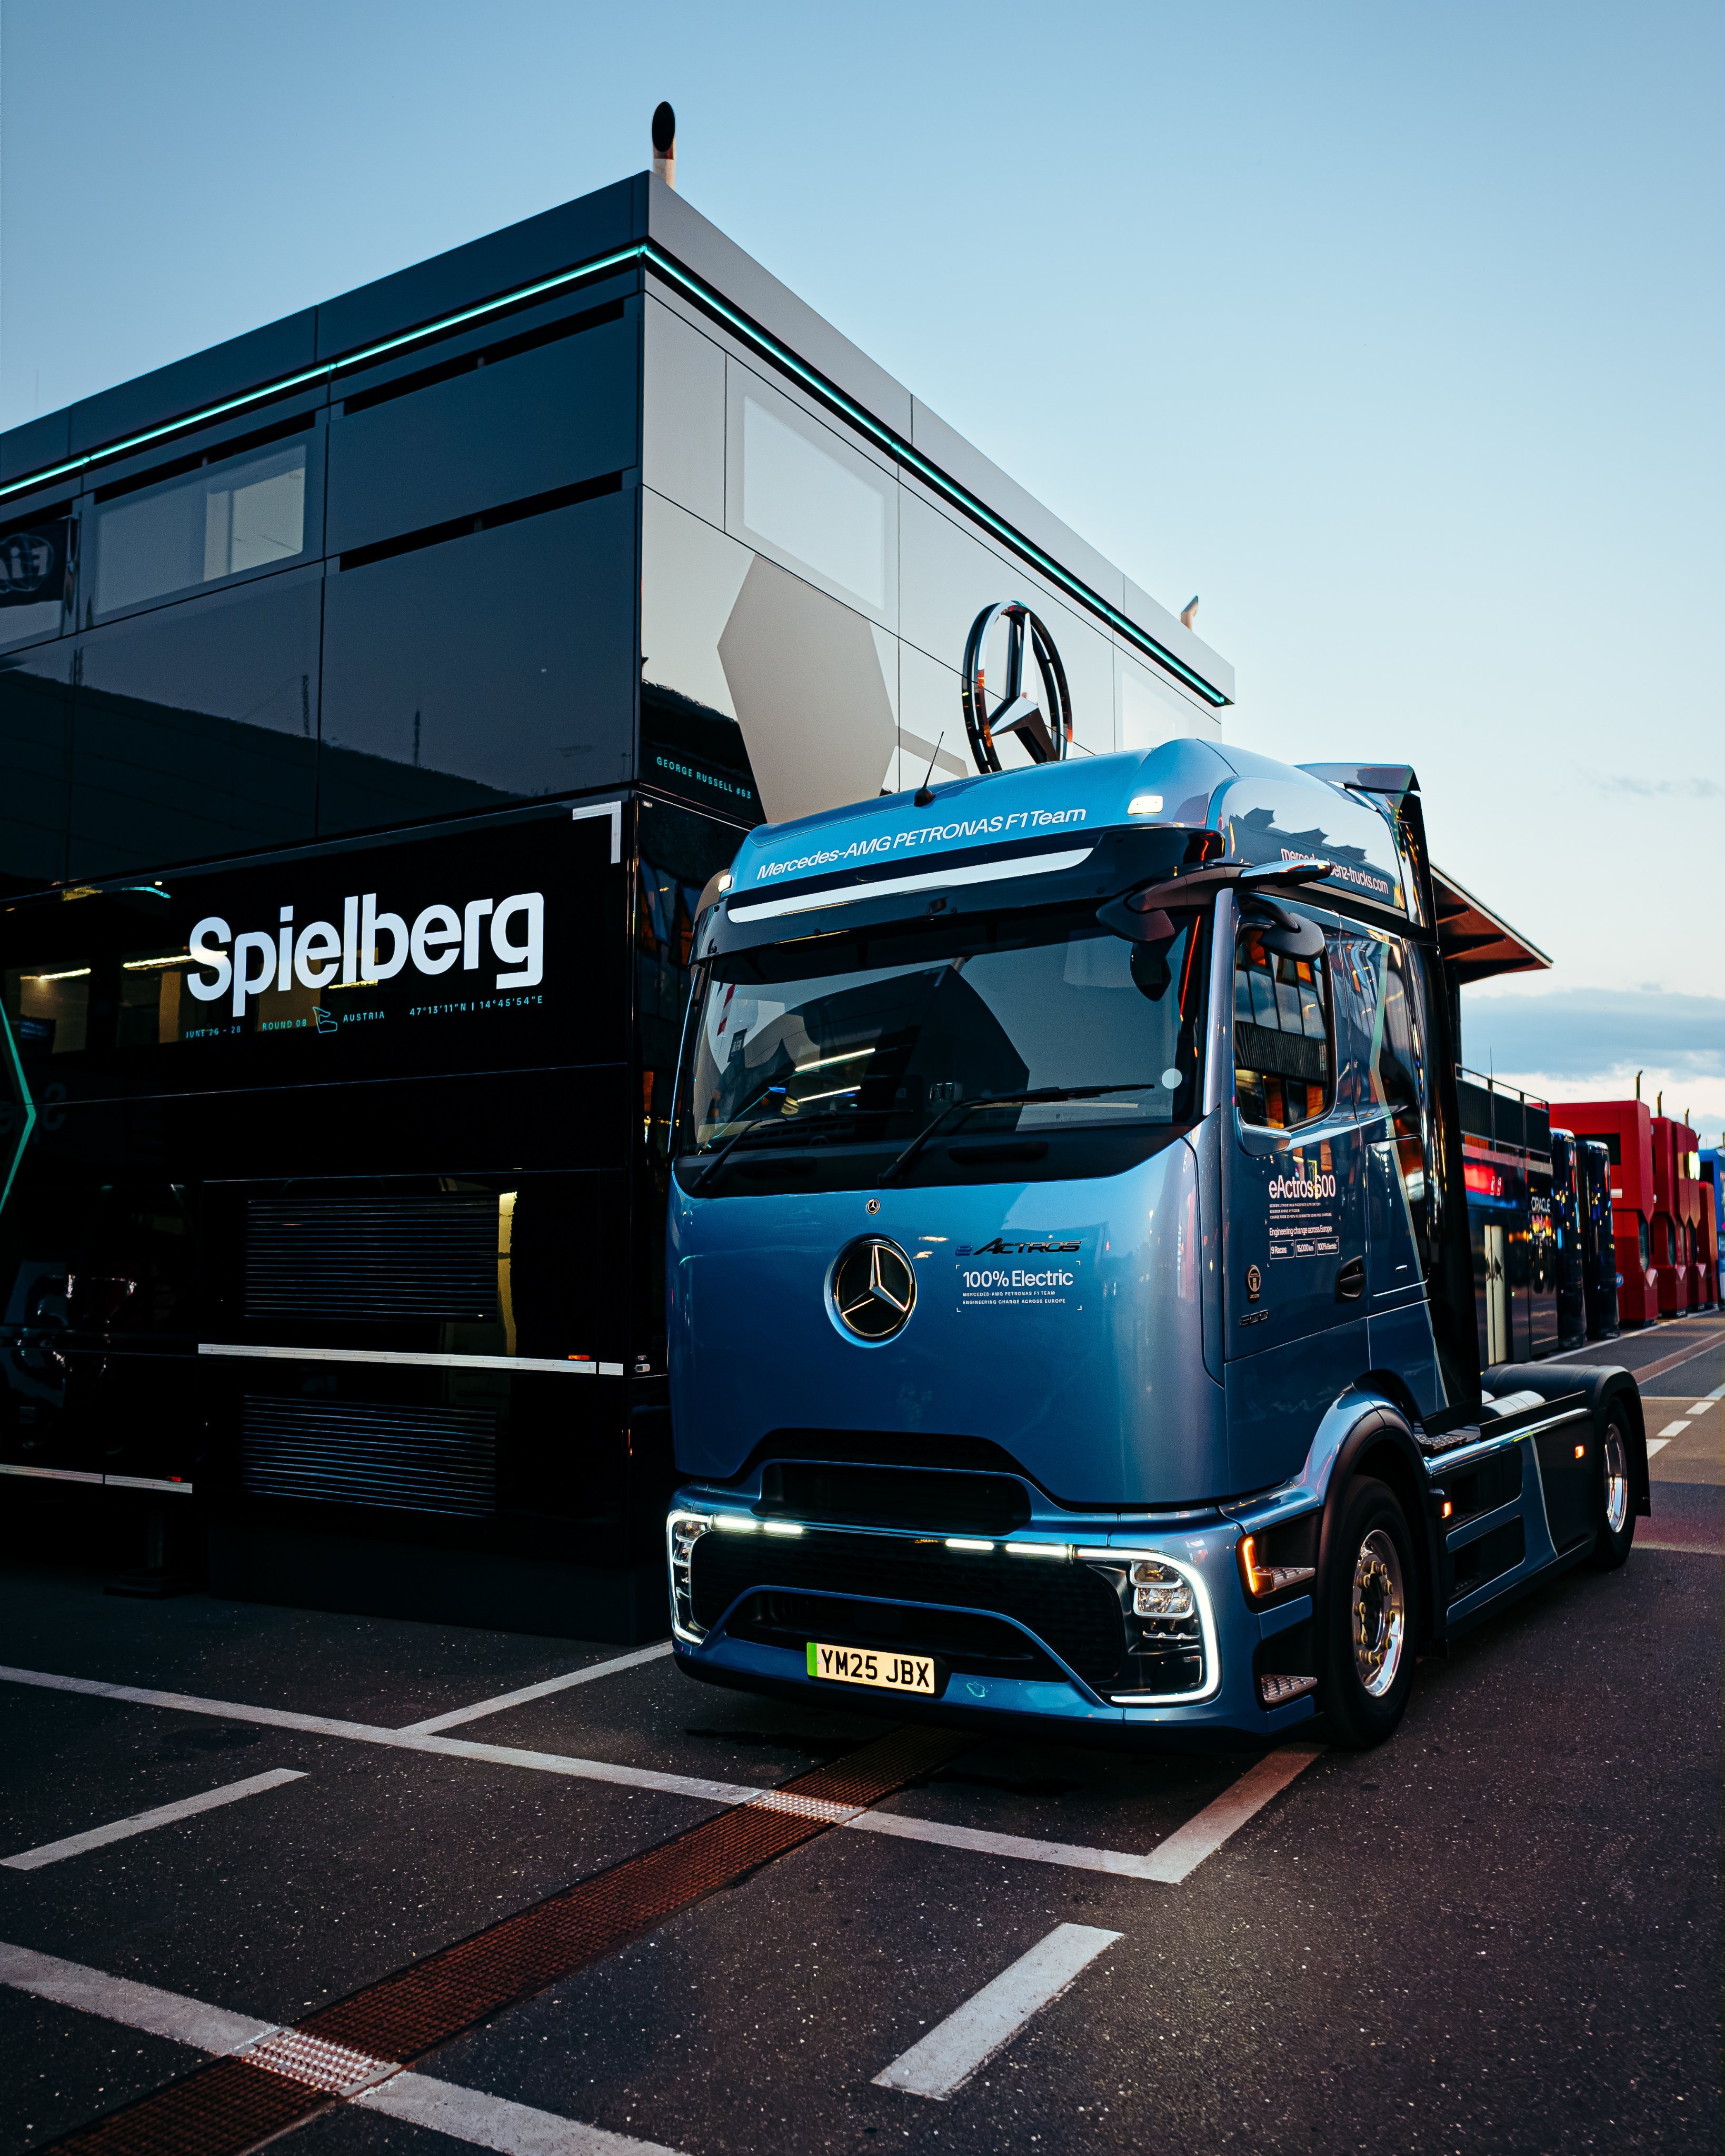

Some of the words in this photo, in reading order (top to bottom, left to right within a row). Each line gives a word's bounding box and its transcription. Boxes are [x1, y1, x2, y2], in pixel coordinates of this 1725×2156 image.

[656, 756, 693, 777] GEORGE
[696, 772, 733, 792] RUSSELL
[736, 787, 752, 799] #63
[756, 836, 892, 881] Mercedes-AMG
[893, 816, 1004, 849] PETRONAS
[1032, 808, 1086, 826] Team
[187, 892, 544, 1017] Spielberg
[186, 1030, 205, 1039] JUNE
[262, 1020, 292, 1030] ROUND
[343, 1011, 385, 1022] AUSTRIA
[1269, 1175, 1314, 1199] eActros
[1314, 1174, 1336, 1198] 600
[1531, 1196, 1551, 1213] ORACLE
[1269, 1227, 1293, 1237] Engineering
[1293, 1226, 1308, 1235] change
[1320, 1225, 1332, 1233] Europe
[963, 1270, 1010, 1287] 100%
[1012, 1269, 1074, 1287] Electric
[821, 1649, 878, 1680] YM25
[885, 1658, 930, 1688] JBX
